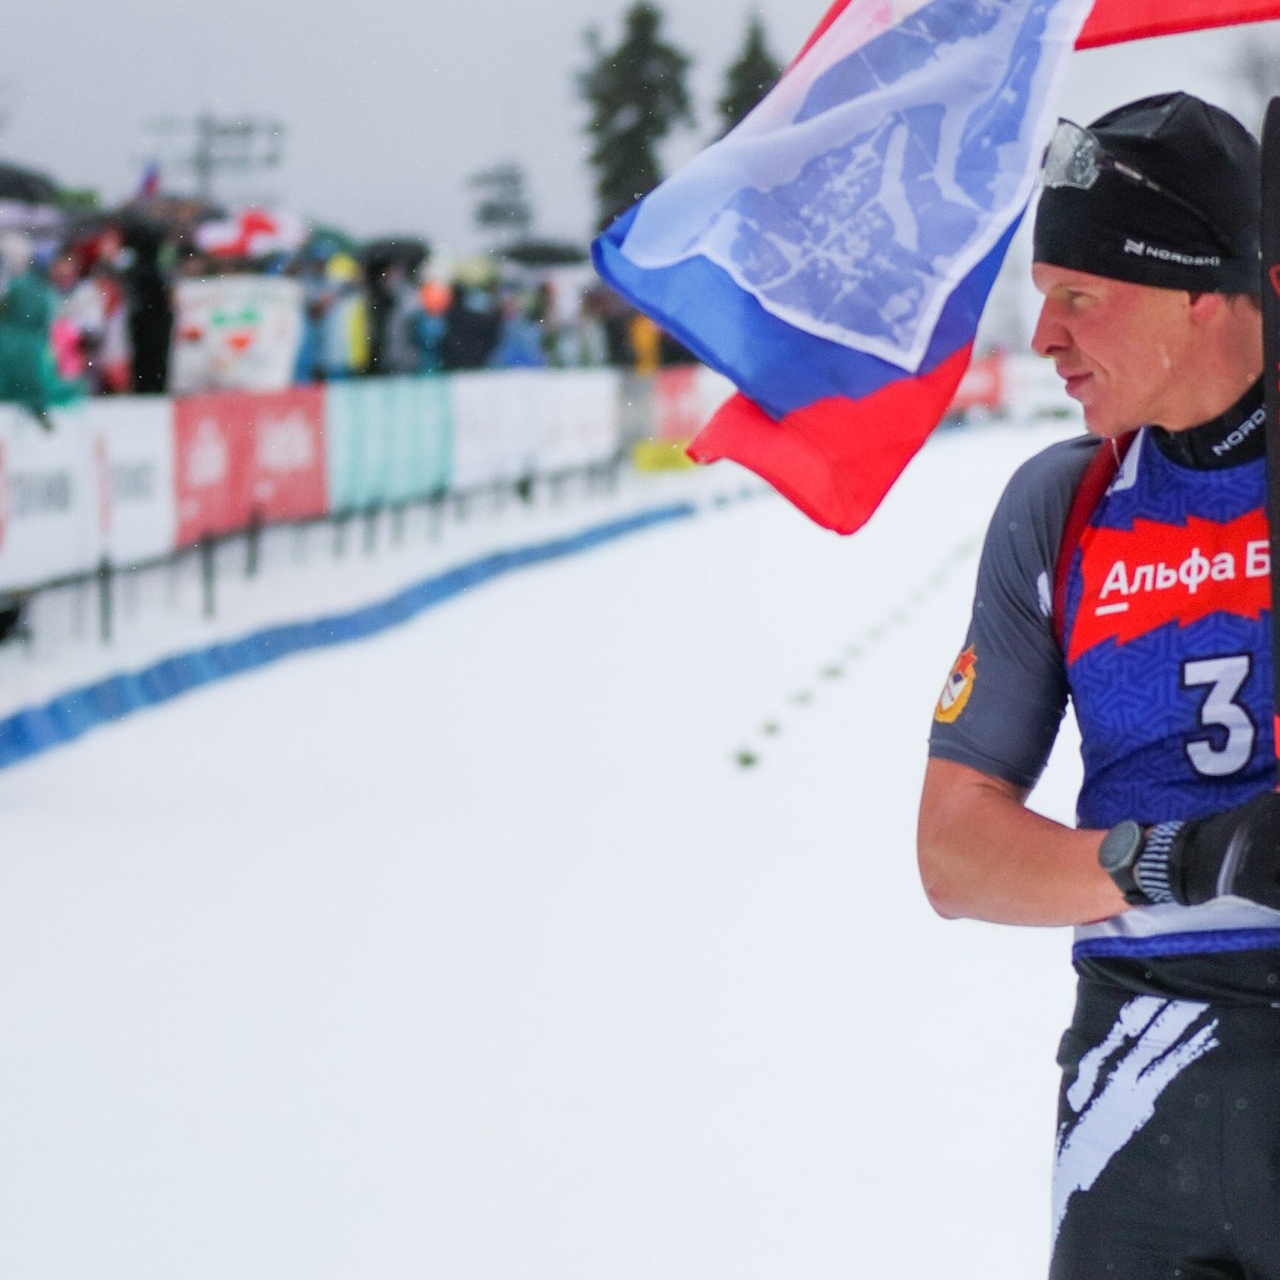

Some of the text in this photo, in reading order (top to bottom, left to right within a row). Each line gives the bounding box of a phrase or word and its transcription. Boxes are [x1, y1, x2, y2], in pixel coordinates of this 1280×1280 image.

[1212, 406, 1266, 456] NORD
[1098, 547, 1236, 603] Альфа
[1184, 654, 1255, 777] 3
